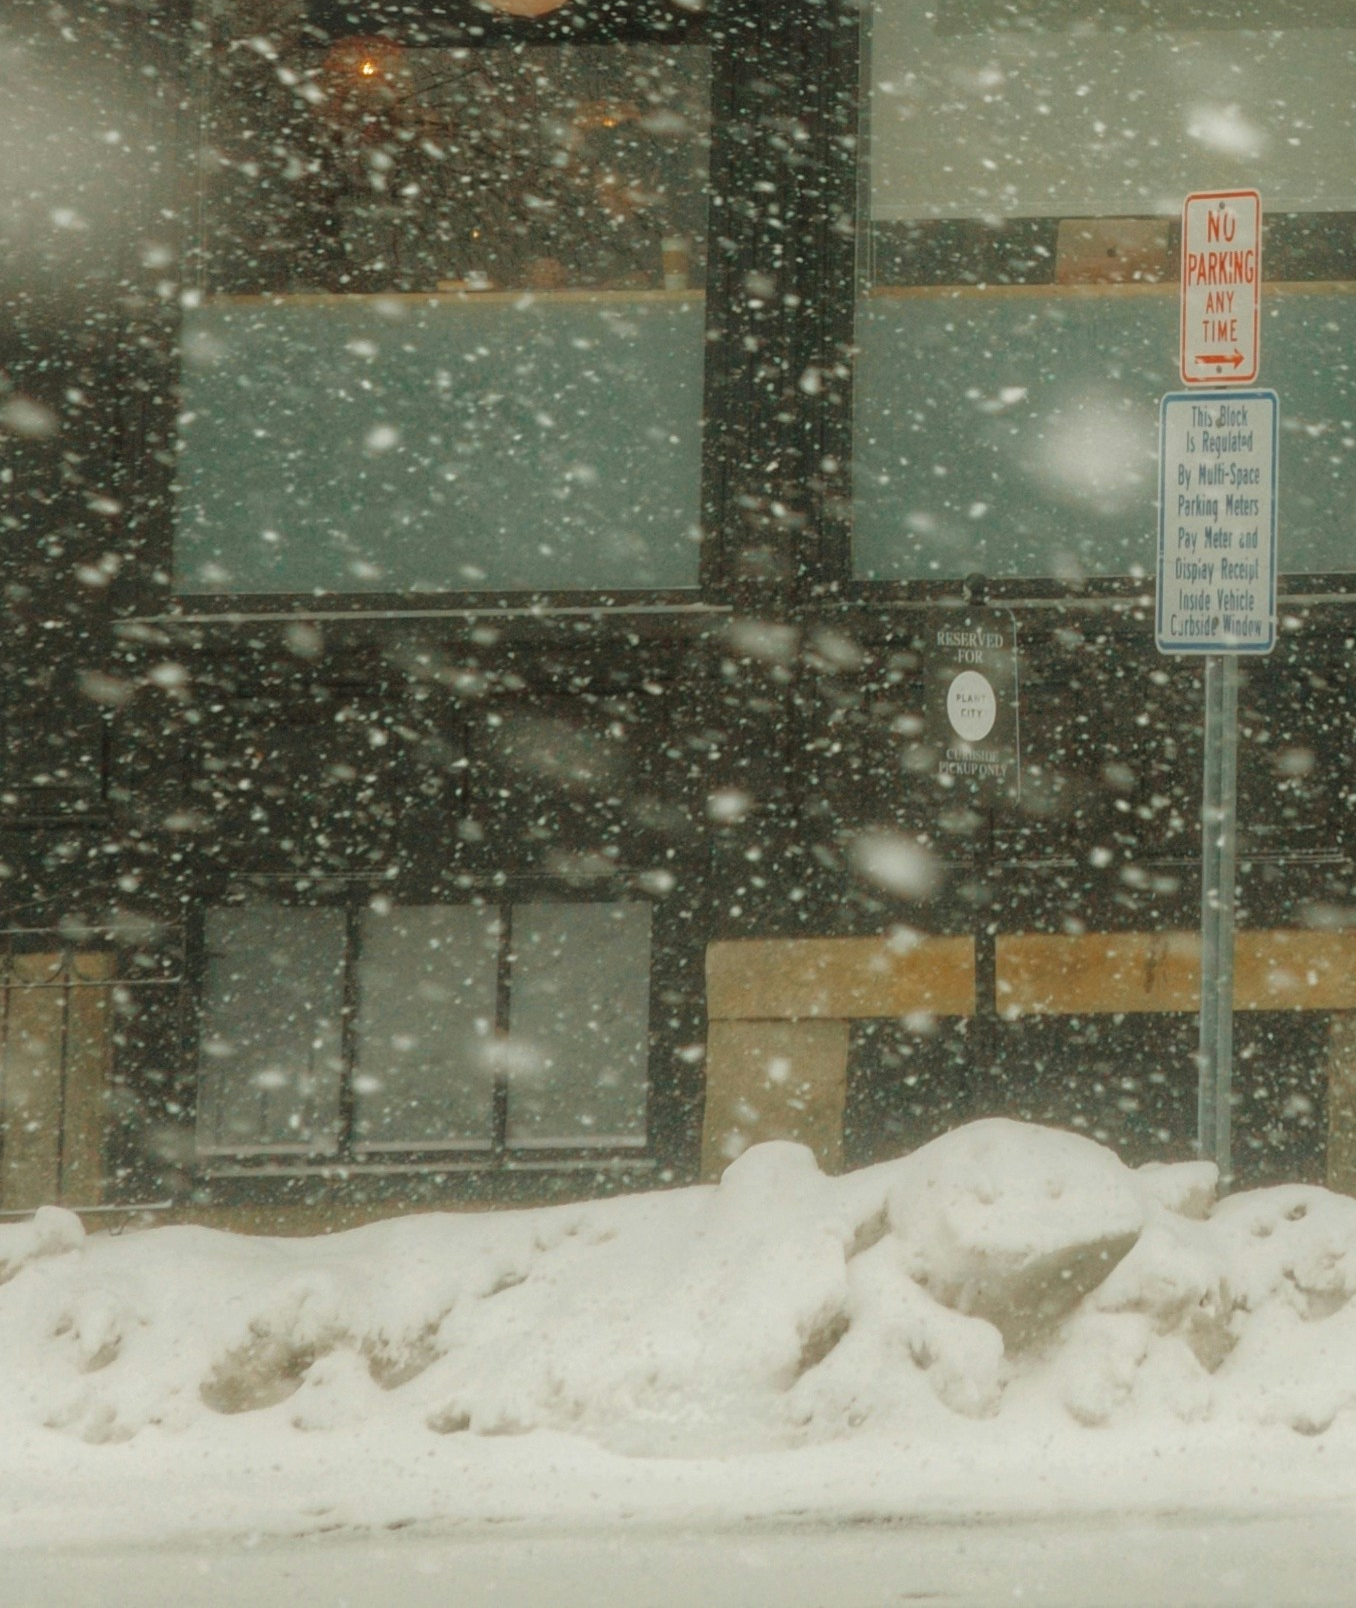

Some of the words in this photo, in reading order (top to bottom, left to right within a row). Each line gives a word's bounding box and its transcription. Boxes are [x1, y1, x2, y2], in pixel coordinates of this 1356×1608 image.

[1207, 210, 1236, 243] NO
[1188, 250, 1254, 286] PARKING
[1206, 290, 1235, 314] ANY
[1202, 319, 1237, 343] TIME
[1192, 405, 1212, 427] This
[1219, 405, 1248, 427] Block
[1186, 431, 1195, 453] Is
[1202, 430, 1253, 459] Regulated
[1178, 464, 1191, 491] By
[1199, 462, 1260, 490] Multi-Space
[1178, 494, 1218, 523] Parking
[1225, 493, 1259, 516] Meters
[1178, 527, 1197, 554] Pay
[1204, 526, 1233, 548] Meter
[1239, 527, 1258, 549] and
[1175, 557, 1214, 585] Display
[1221, 557, 1259, 584] Receipt
[1179, 588, 1211, 611] Inside
[1217, 588, 1254, 611] Vehicle
[1170, 613, 1217, 637] Curbside
[1222, 613, 1262, 637] Window
[937, 631, 1004, 648] RESERVED
[957, 649, 983, 663] FOR
[960, 708, 983, 718] CITY
[939, 761, 977, 775] PICKUP
[979, 762, 1008, 777] ONLY
